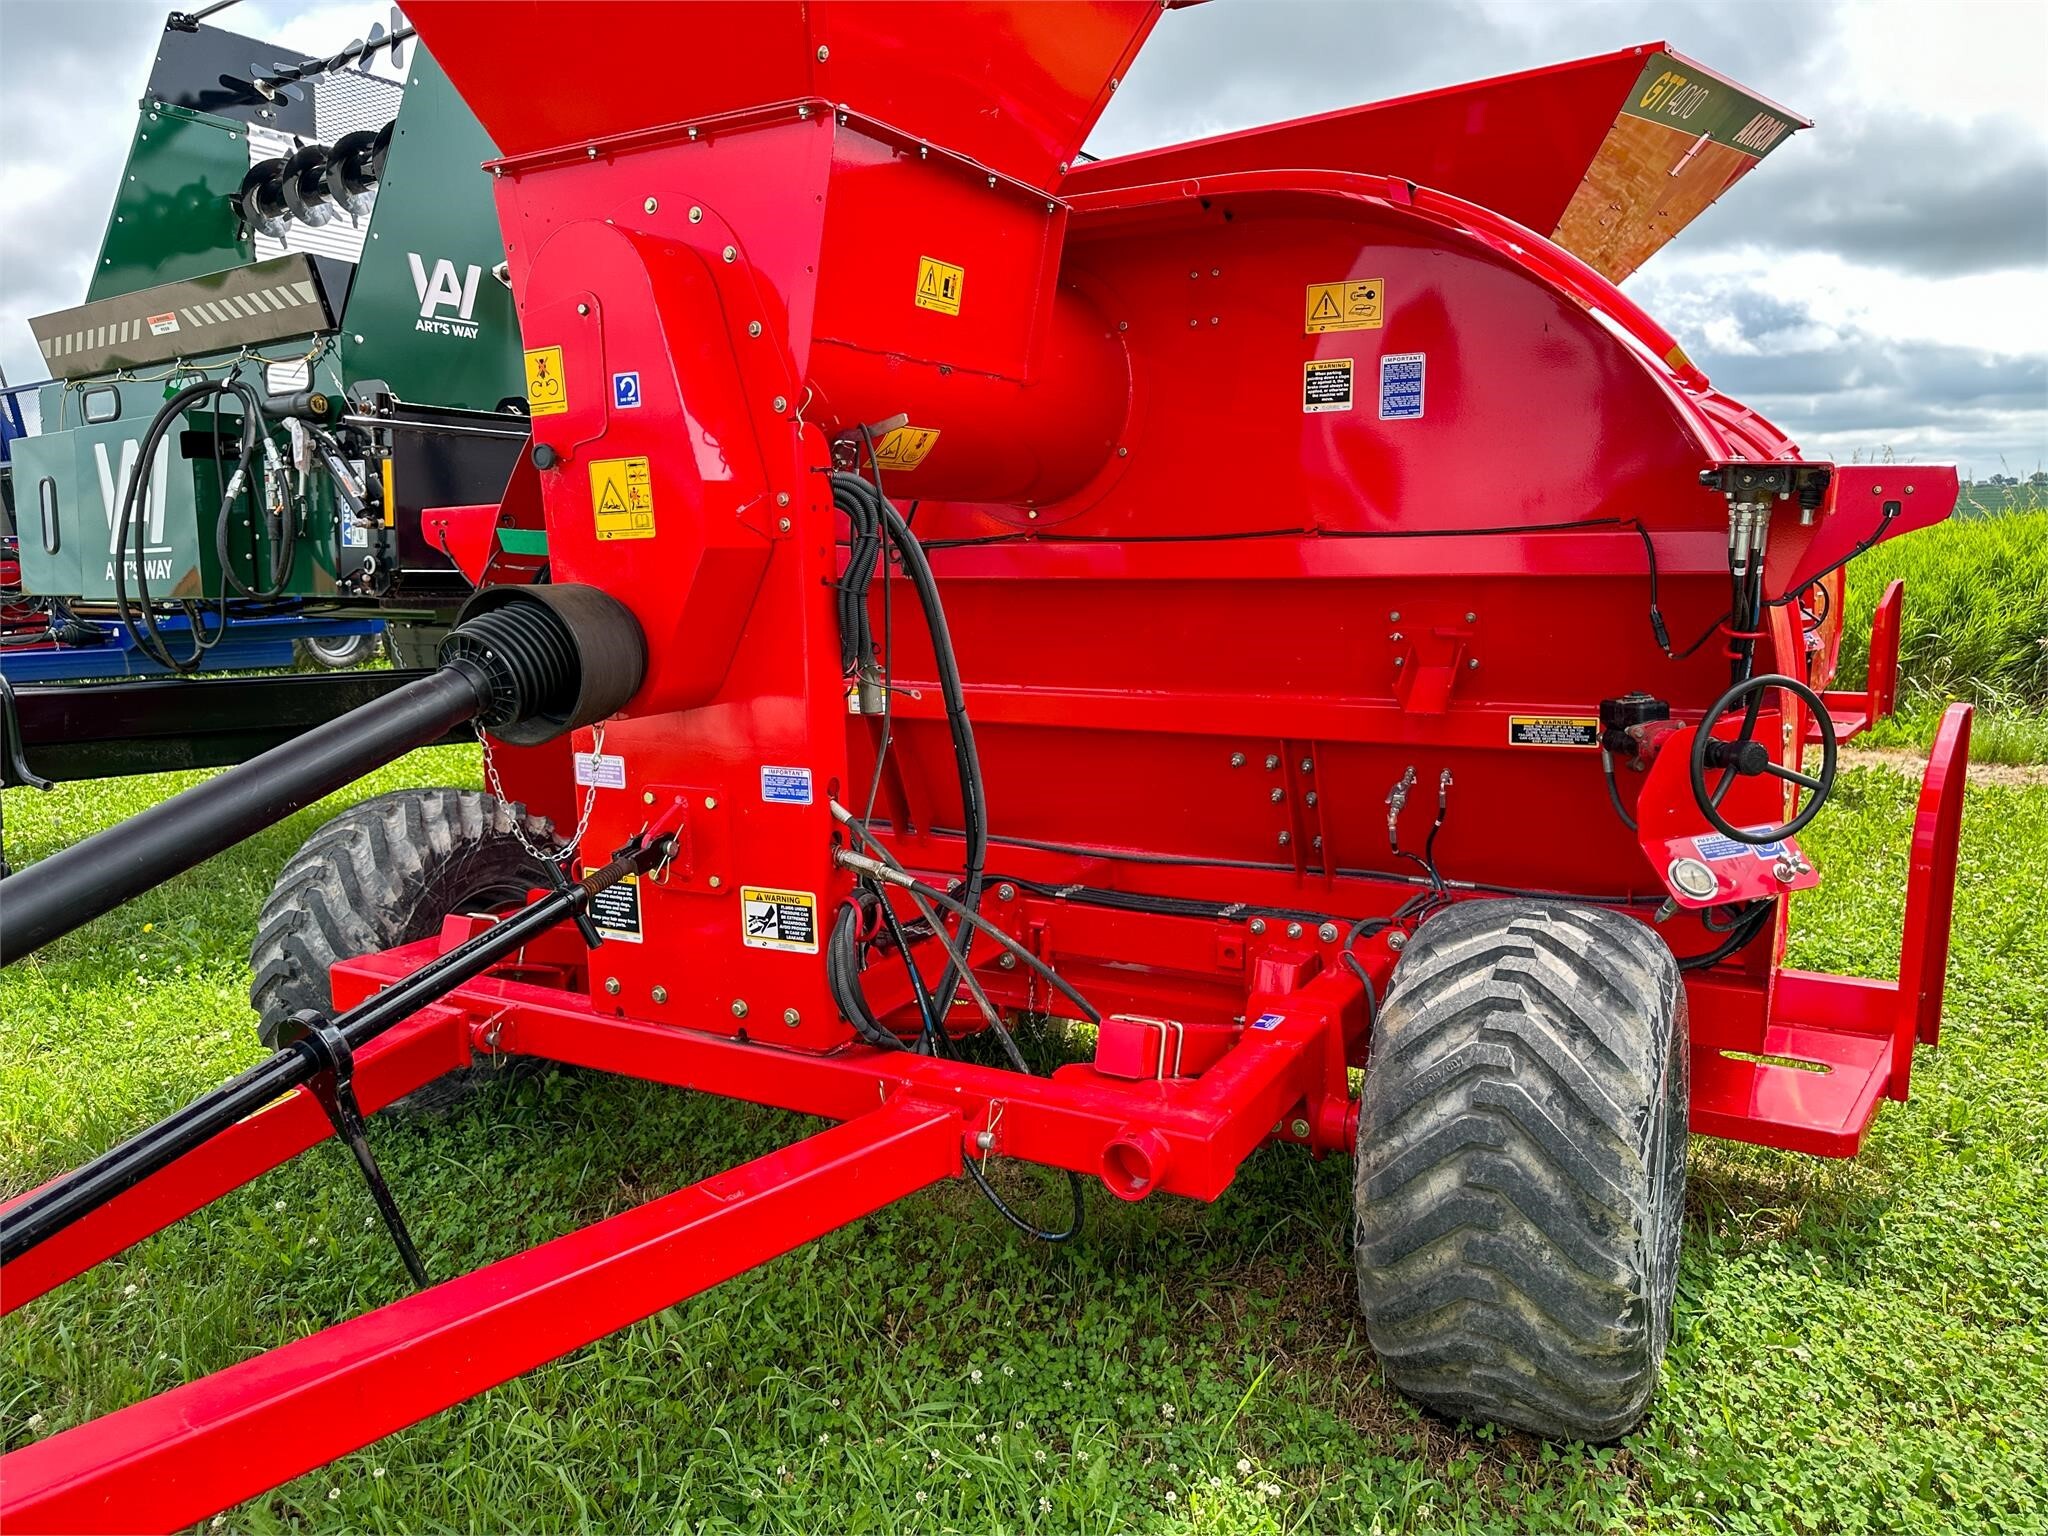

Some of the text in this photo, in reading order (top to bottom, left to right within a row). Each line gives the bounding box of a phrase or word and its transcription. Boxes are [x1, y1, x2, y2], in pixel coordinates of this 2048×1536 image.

[1732, 112, 1788, 152] AKRON
[415, 318, 479, 339] ART'S WAY
[144, 560, 172, 580] WAY
[764, 894, 800, 904] WARNING
